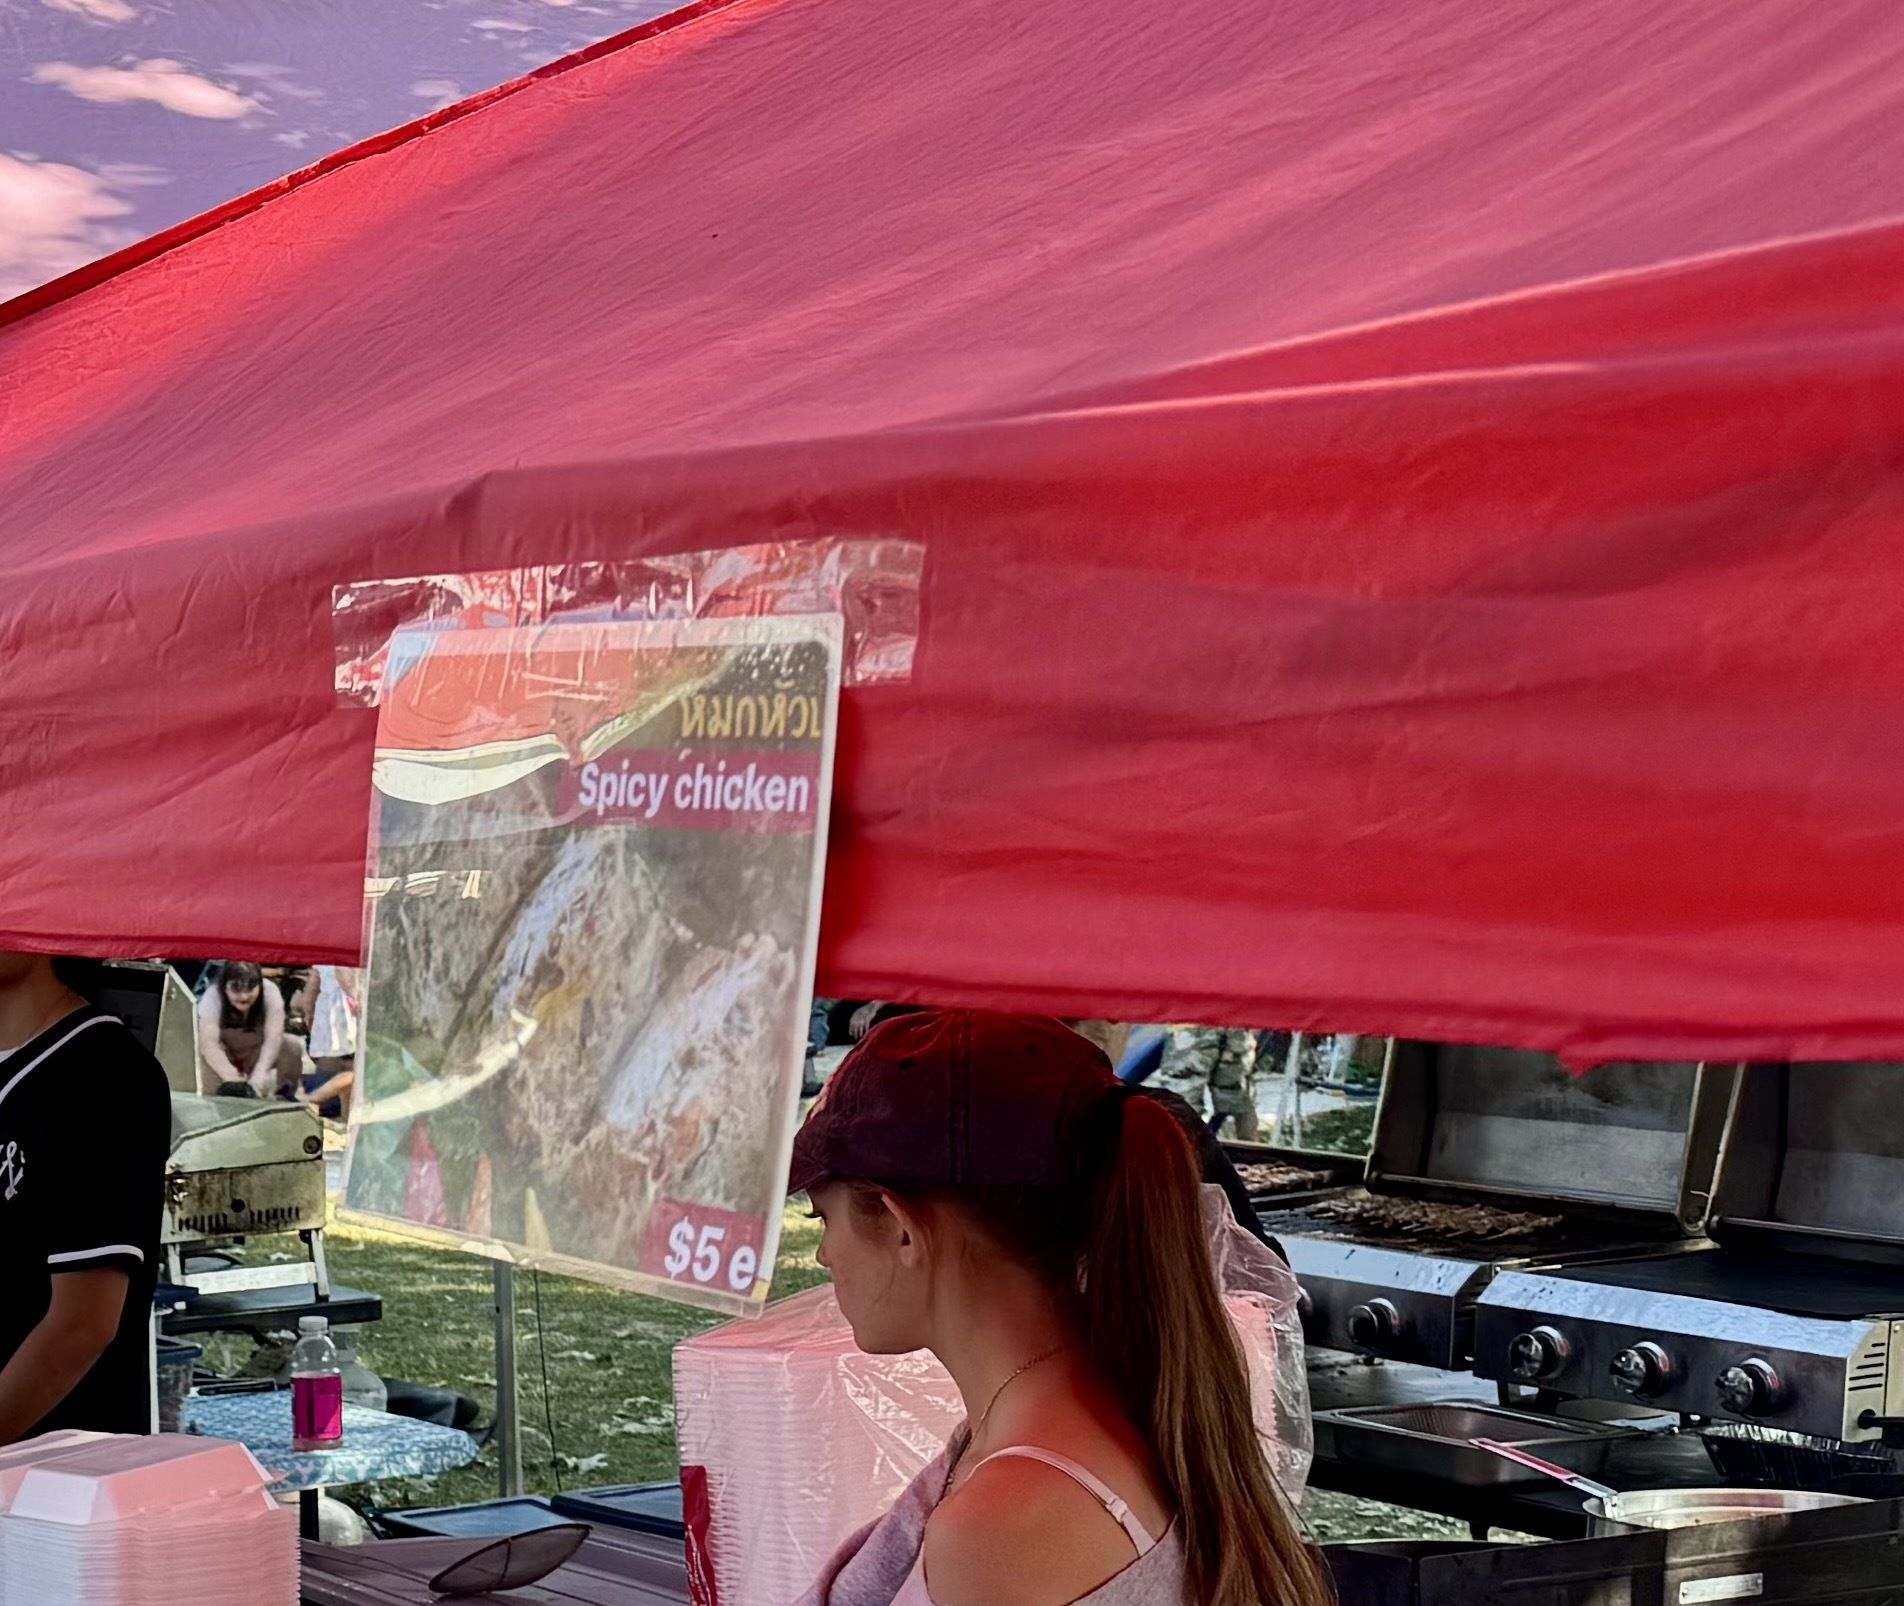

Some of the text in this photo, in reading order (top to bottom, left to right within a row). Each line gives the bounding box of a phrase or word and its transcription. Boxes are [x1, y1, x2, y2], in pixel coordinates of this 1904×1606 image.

[578, 759, 809, 818] Spicy chicken
[664, 1216, 725, 1282] $5
